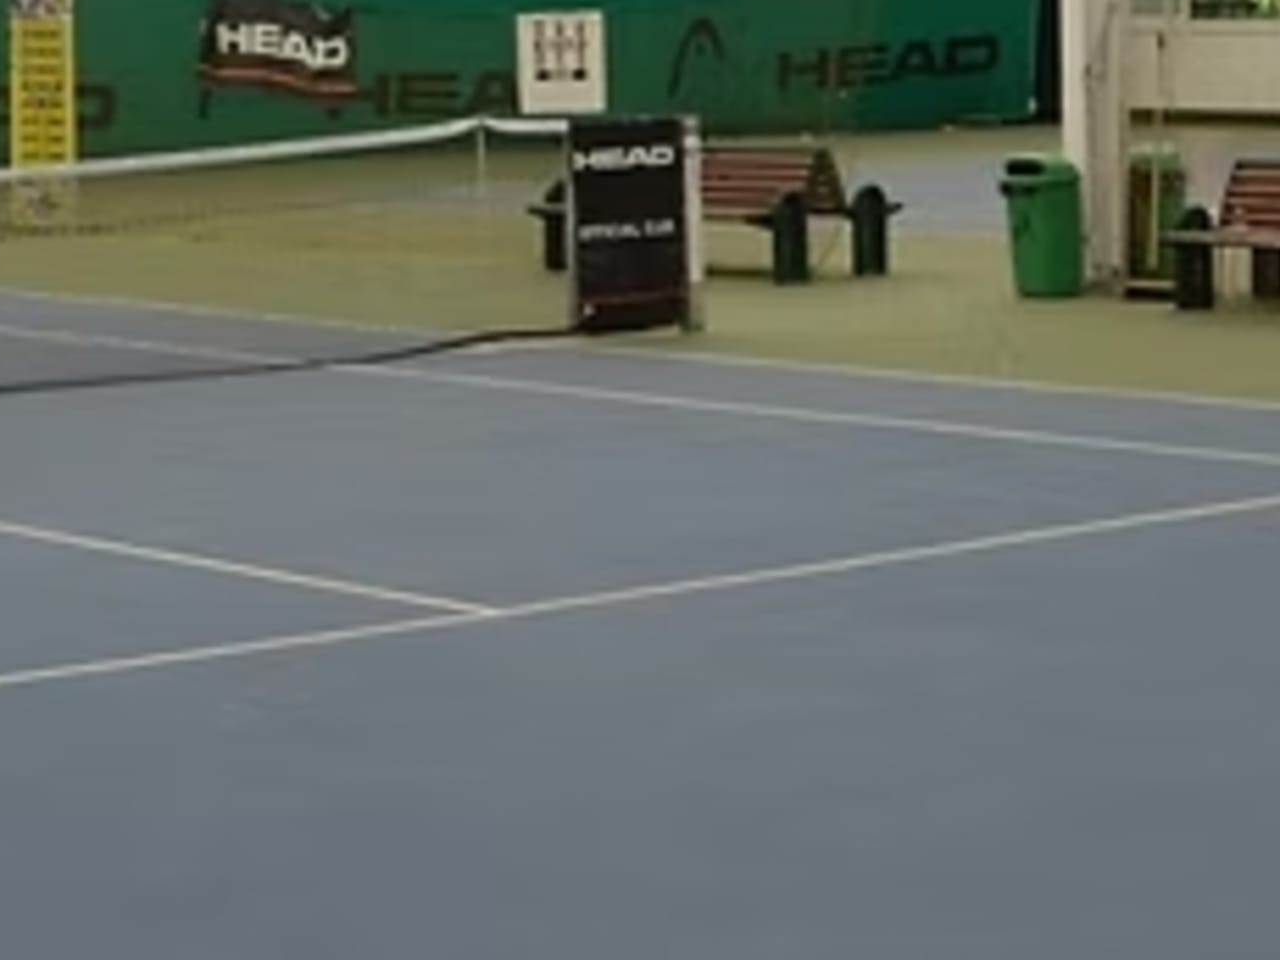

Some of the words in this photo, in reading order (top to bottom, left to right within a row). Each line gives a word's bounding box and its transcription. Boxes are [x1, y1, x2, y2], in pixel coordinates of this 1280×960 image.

[216, 22, 347, 70] HEAD
[776, 33, 1000, 91] HEAD
[572, 145, 675, 172] HEAD
